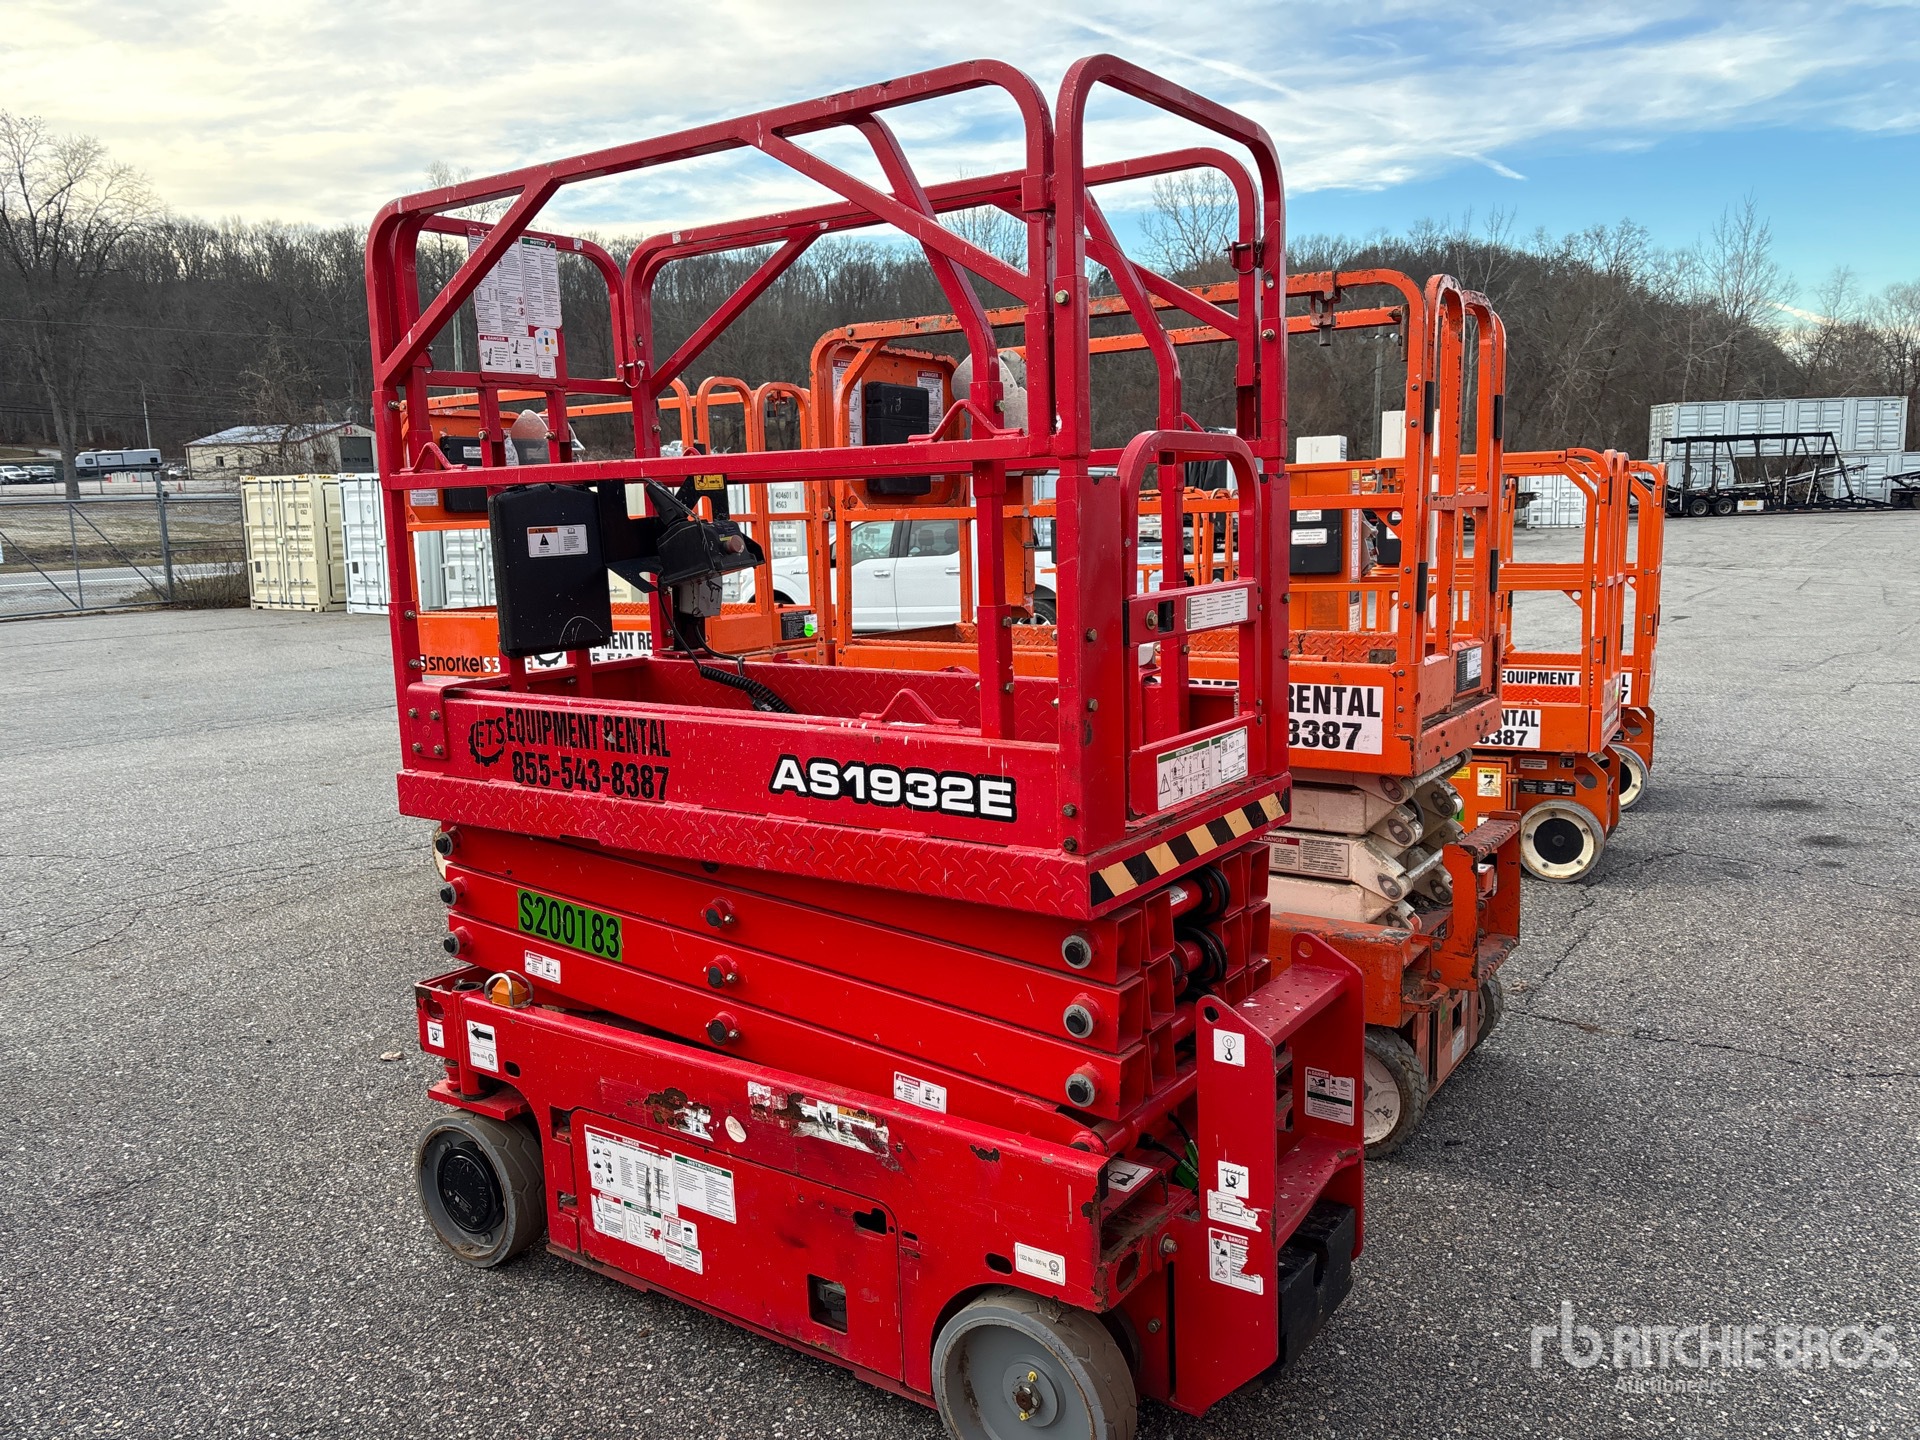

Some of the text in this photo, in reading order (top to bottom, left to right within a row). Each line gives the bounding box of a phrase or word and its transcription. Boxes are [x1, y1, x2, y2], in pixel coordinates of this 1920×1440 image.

[428, 655, 483, 673] snorkel
[505, 707, 598, 750] EQUIPMENT
[603, 715, 671, 757] RENTAL
[511, 750, 670, 800] 855-543-8387
[771, 757, 1014, 819] AS1932E
[1263, 835, 1288, 844] DANGER
[519, 891, 621, 959] S200183
